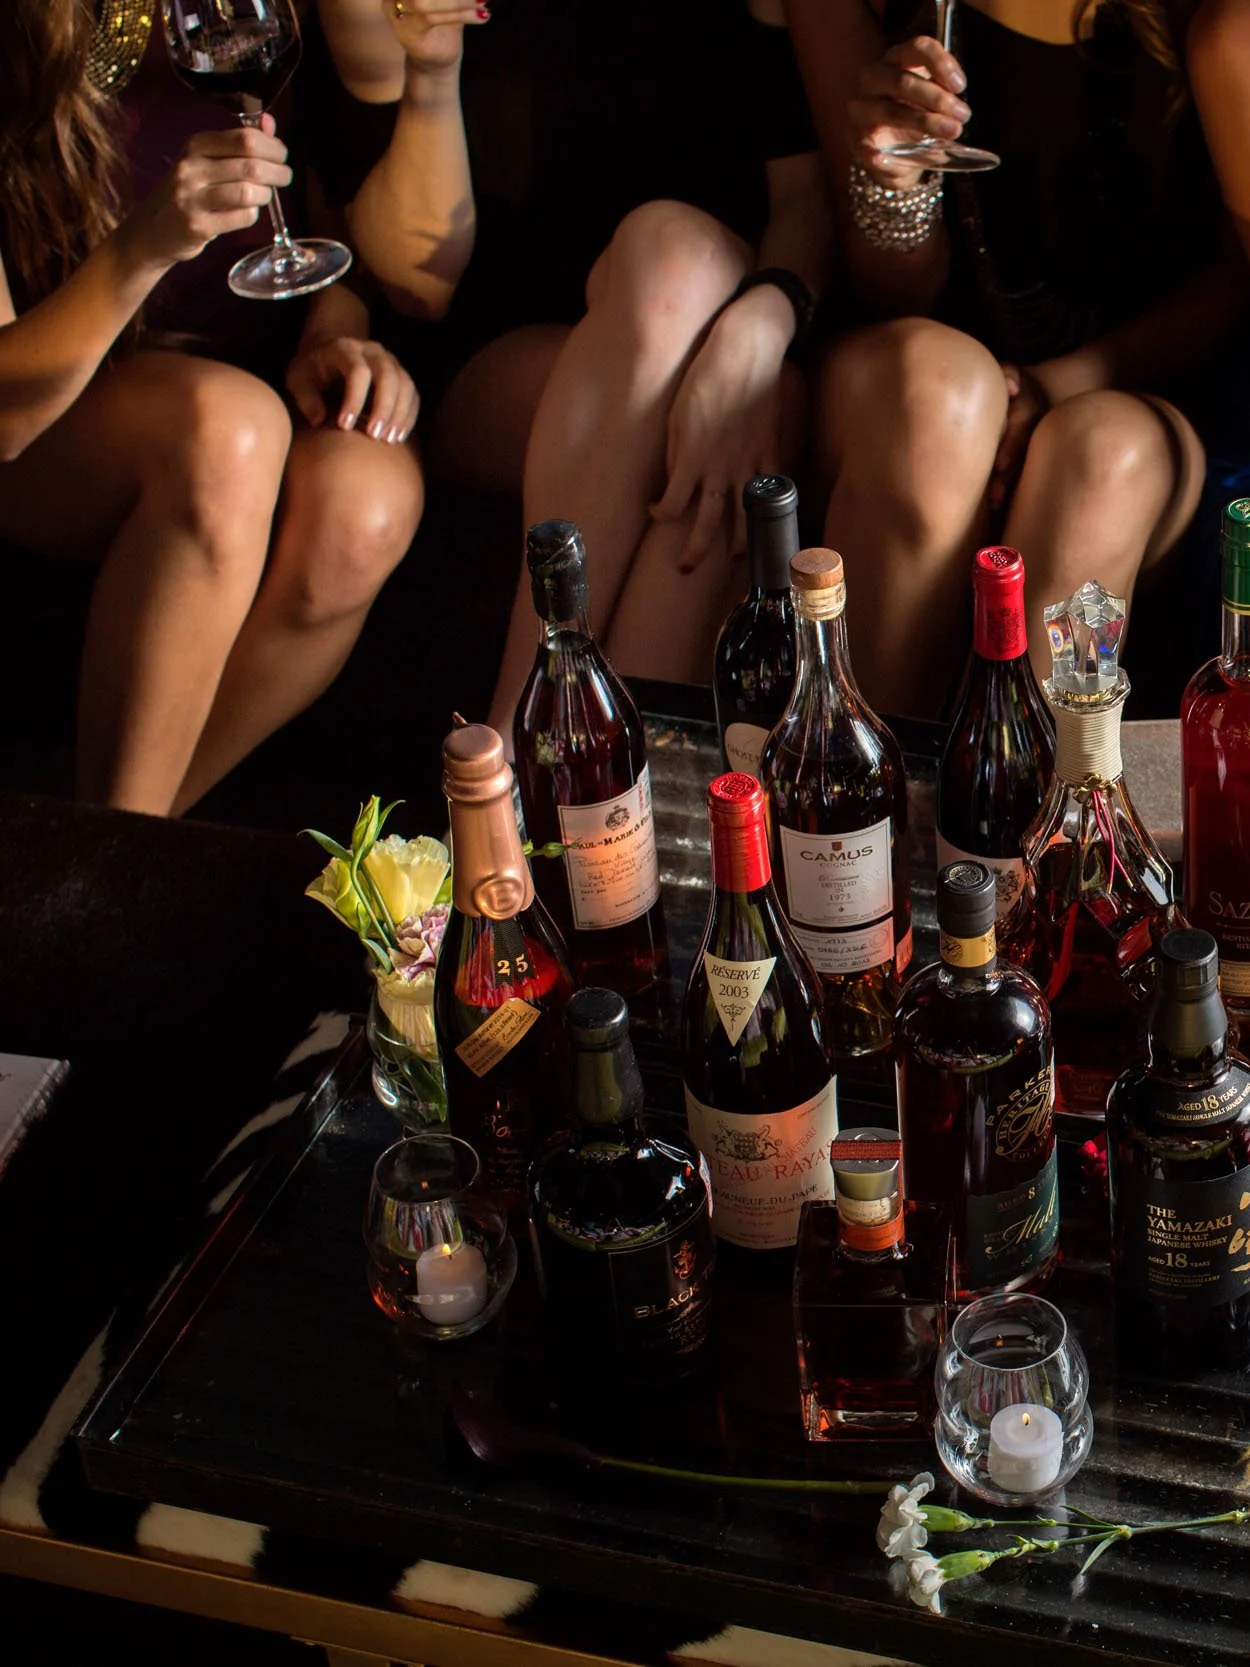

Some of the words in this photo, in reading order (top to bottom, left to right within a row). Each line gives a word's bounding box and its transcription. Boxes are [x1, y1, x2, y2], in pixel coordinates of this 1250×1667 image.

[799, 845, 874, 862] CAMUS
[819, 860, 857, 868] COGNAC
[820, 879, 857, 889] DISTILLED
[829, 893, 851, 902] 1973
[710, 963, 761, 981] RÉSERVÉ
[718, 983, 750, 999] 2003
[1177, 1102, 1202, 1111] AGED
[1201, 1094, 1220, 1112] 18
[1217, 1085, 1238, 1103] YEARS
[1212, 1108, 1226, 1118] MALT
[1146, 1203, 1177, 1219] THE
[1147, 1214, 1233, 1234] YAMAZAKI
[1147, 1228, 1181, 1242] SINGLE
[1182, 1232, 1209, 1242] MALT
[1147, 1236, 1192, 1249] JAPANESE
[1193, 1235, 1229, 1249] WHISKY
[1147, 1255, 1165, 1266] AGED
[1164, 1252, 1189, 1269] 18
[1190, 1259, 1211, 1268] YEARS
